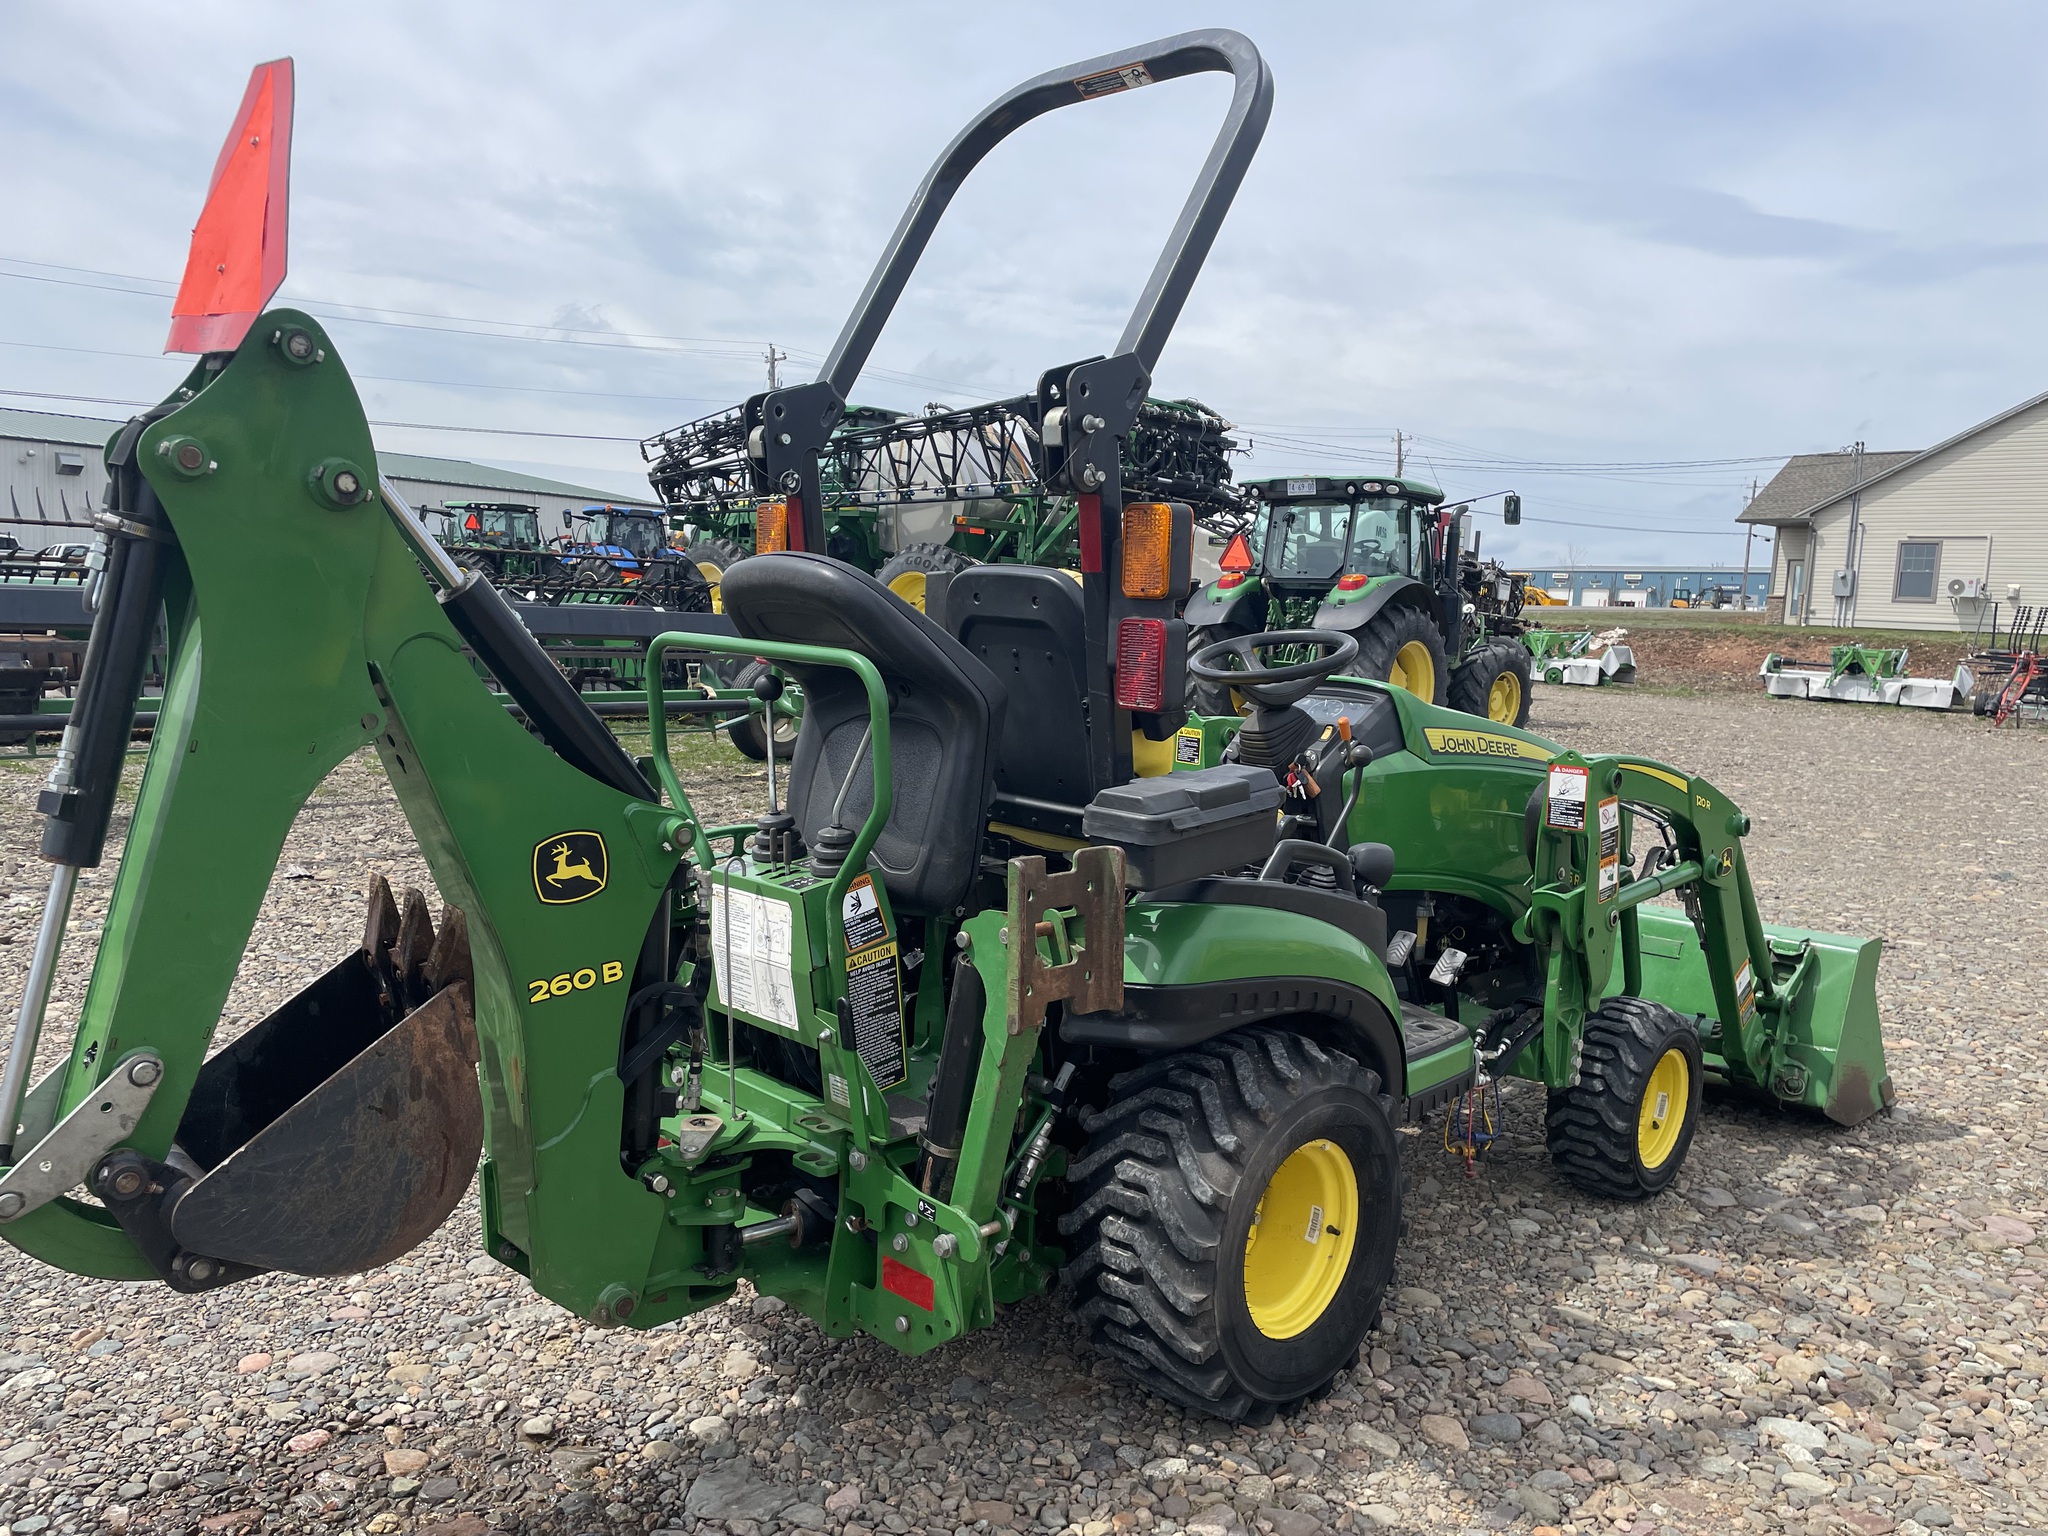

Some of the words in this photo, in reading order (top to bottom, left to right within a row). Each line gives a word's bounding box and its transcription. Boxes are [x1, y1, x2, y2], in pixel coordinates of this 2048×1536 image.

[1440, 735, 1477, 752] JOHN
[1477, 736, 1519, 756] DEERE
[1561, 767, 1584, 775] DANGER
[856, 946, 892, 966] CAUTION
[850, 969, 862, 977] HELP
[862, 963, 876, 973] AVOID
[875, 958, 892, 968] INJURY
[528, 967, 597, 1004] 260
[602, 960, 624, 985] B
